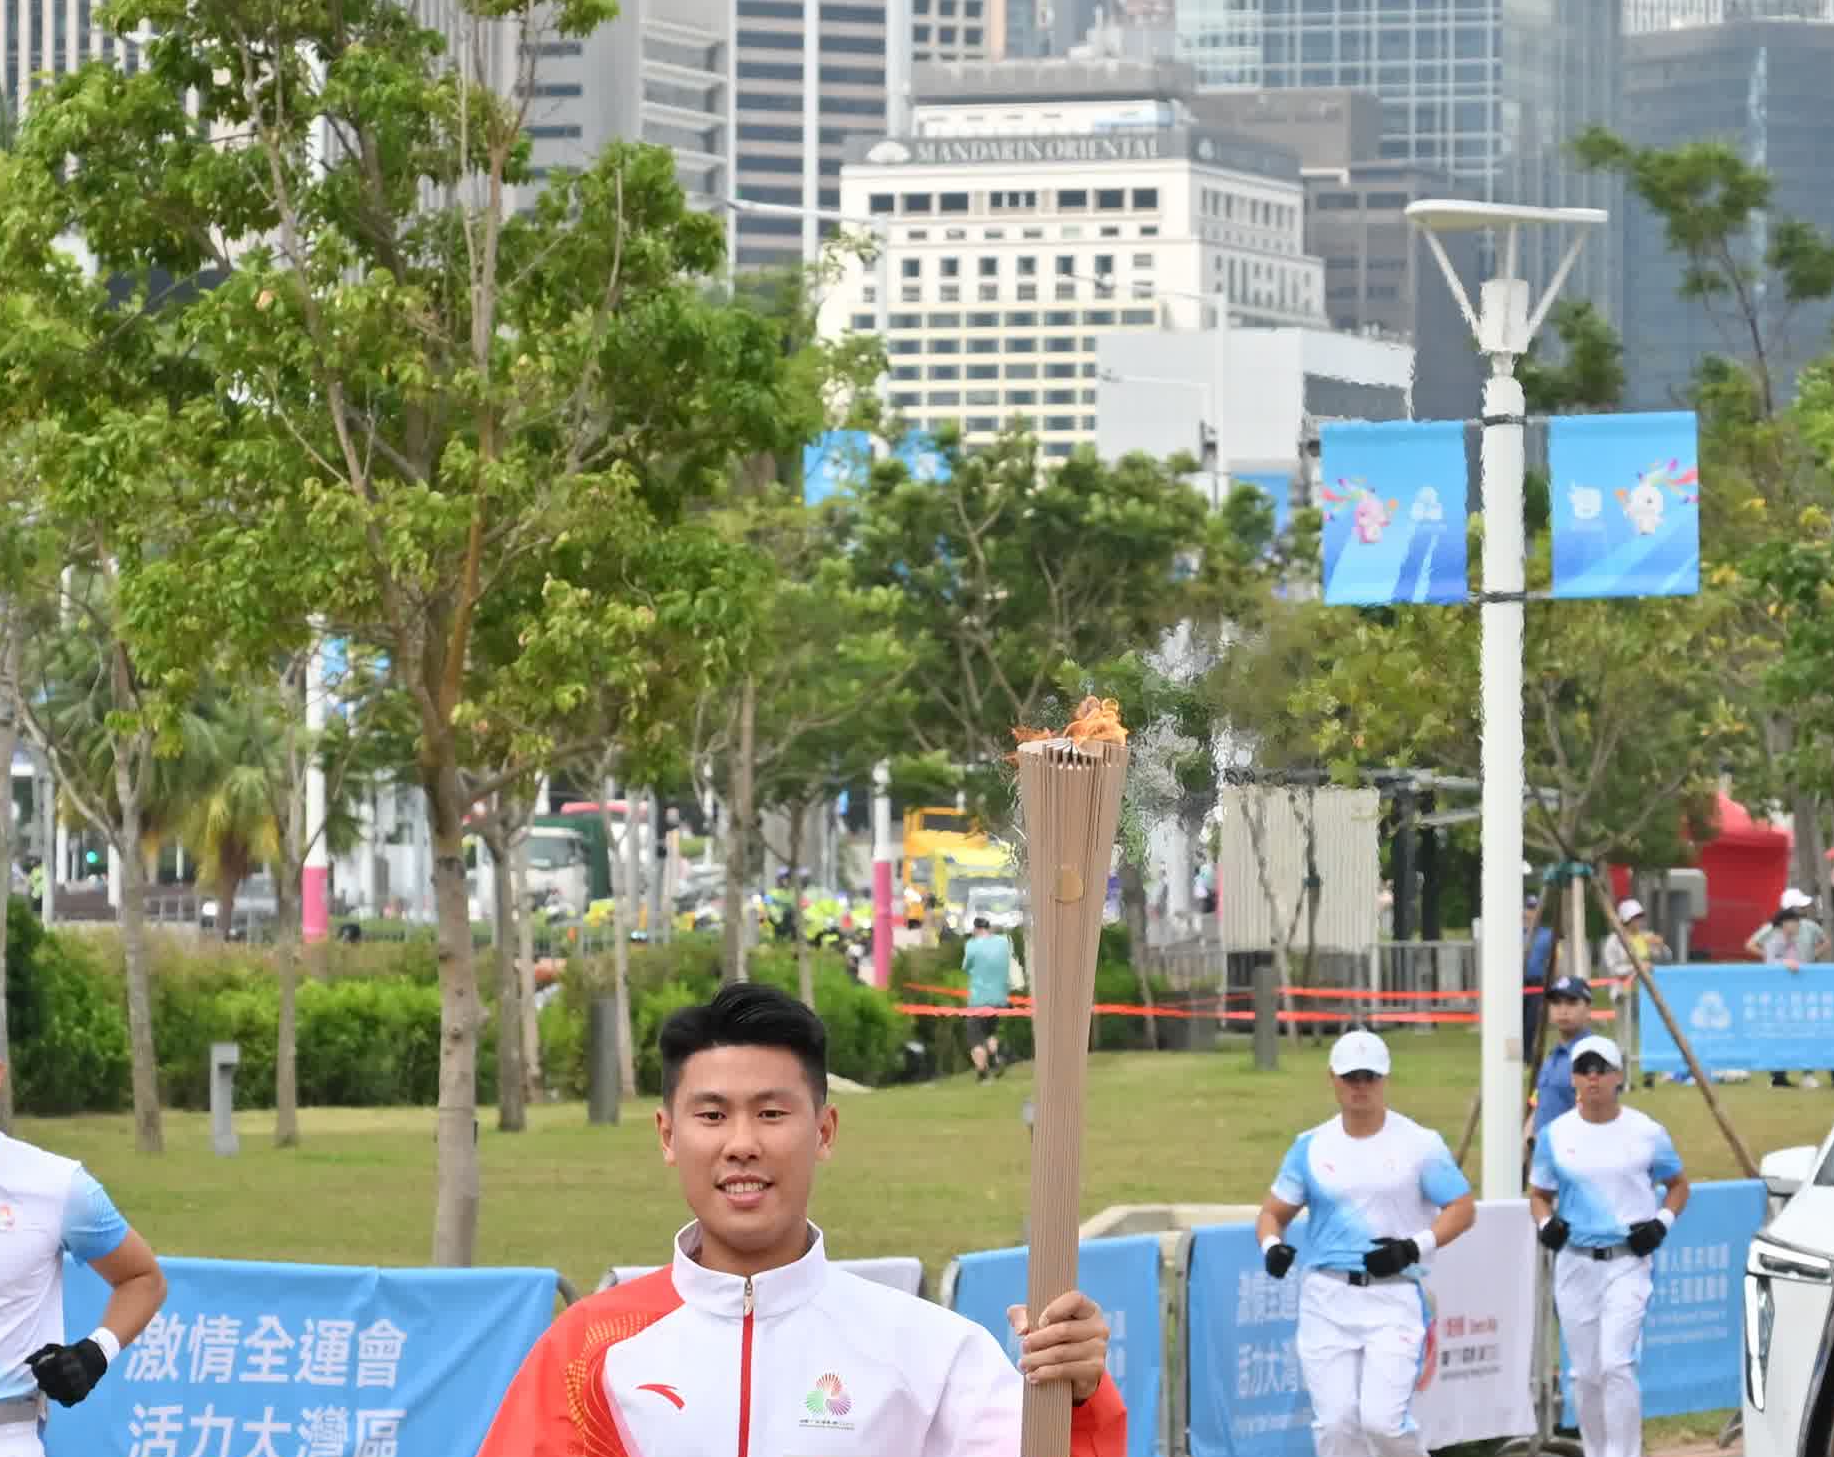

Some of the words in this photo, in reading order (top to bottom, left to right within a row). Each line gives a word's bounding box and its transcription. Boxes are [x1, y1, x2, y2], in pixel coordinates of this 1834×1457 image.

[918, 140, 1044, 161] MANDARIN
[1046, 137, 1160, 161] ORIENTAL
[124, 1312, 408, 1390] 激情全運會
